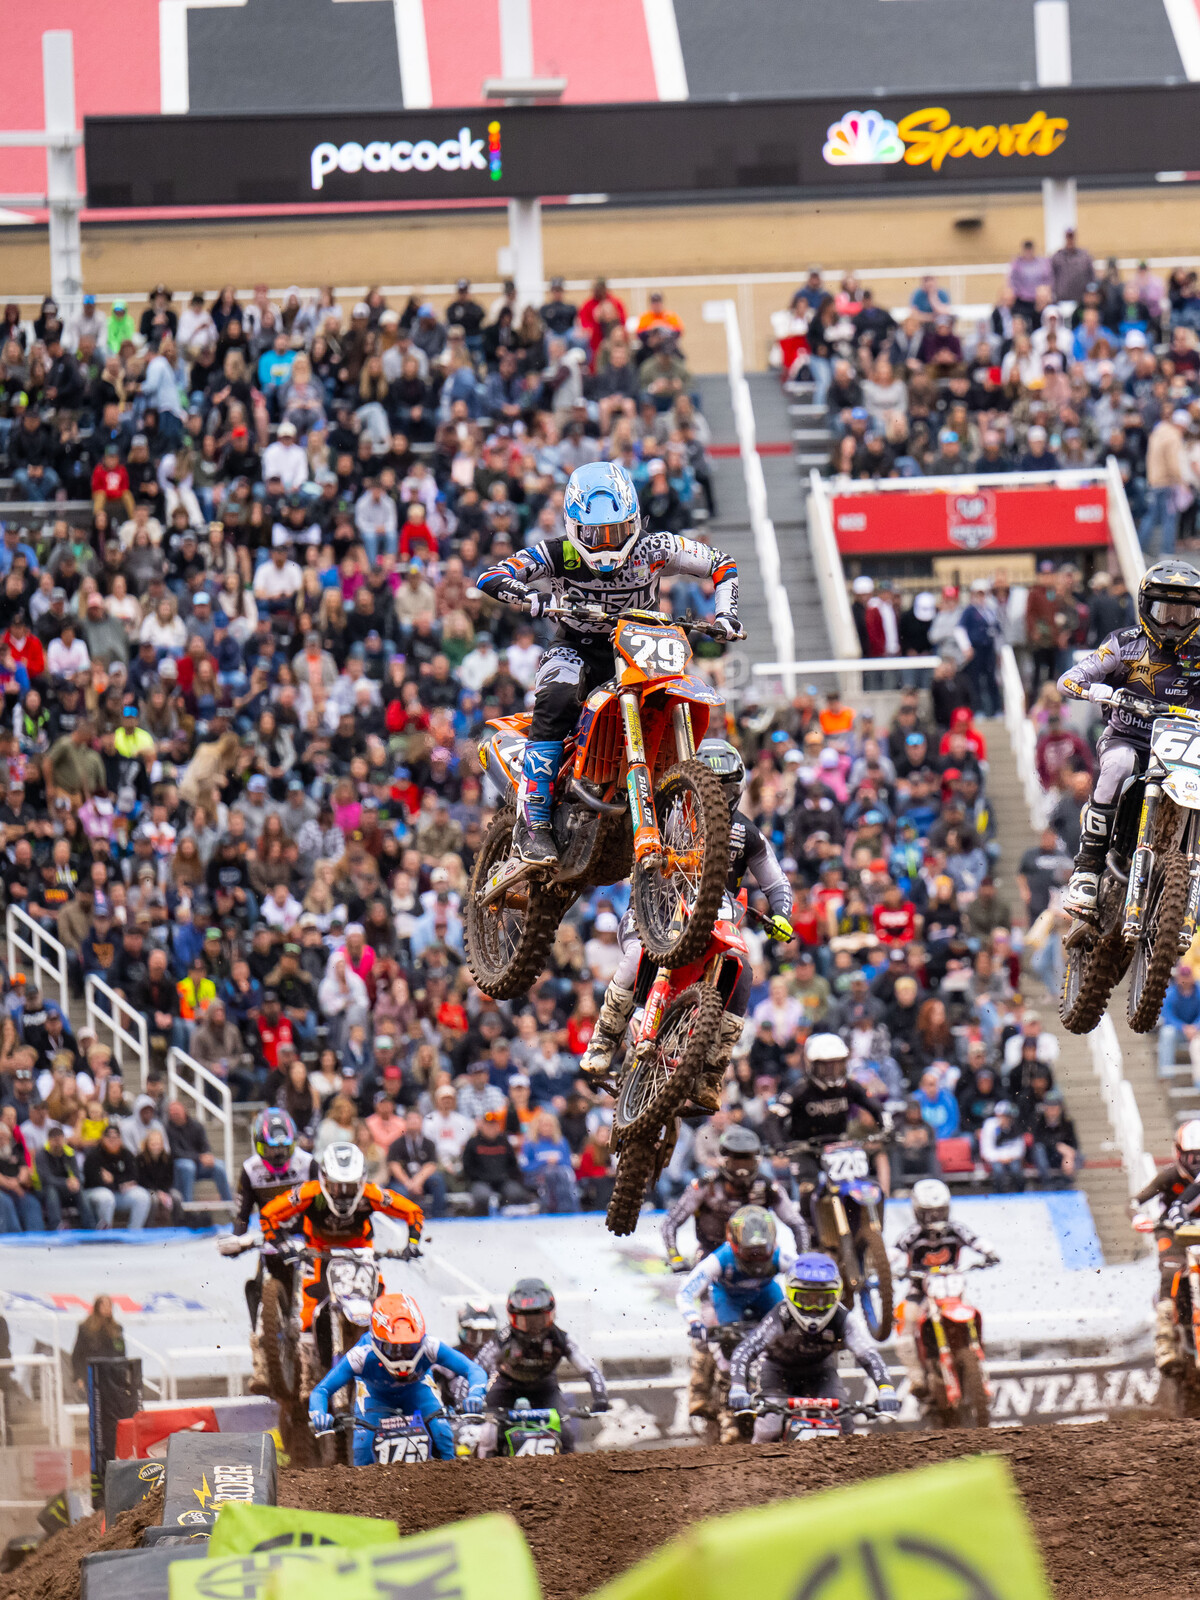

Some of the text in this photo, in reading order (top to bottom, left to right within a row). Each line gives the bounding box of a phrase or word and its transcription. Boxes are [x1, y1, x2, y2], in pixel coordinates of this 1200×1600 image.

[311, 128, 487, 189] peacock
[900, 107, 1069, 171] Sports
[630, 634, 685, 673] 29
[644, 990, 661, 1035] DUNLOP
[213, 1465, 255, 1502] RDER
